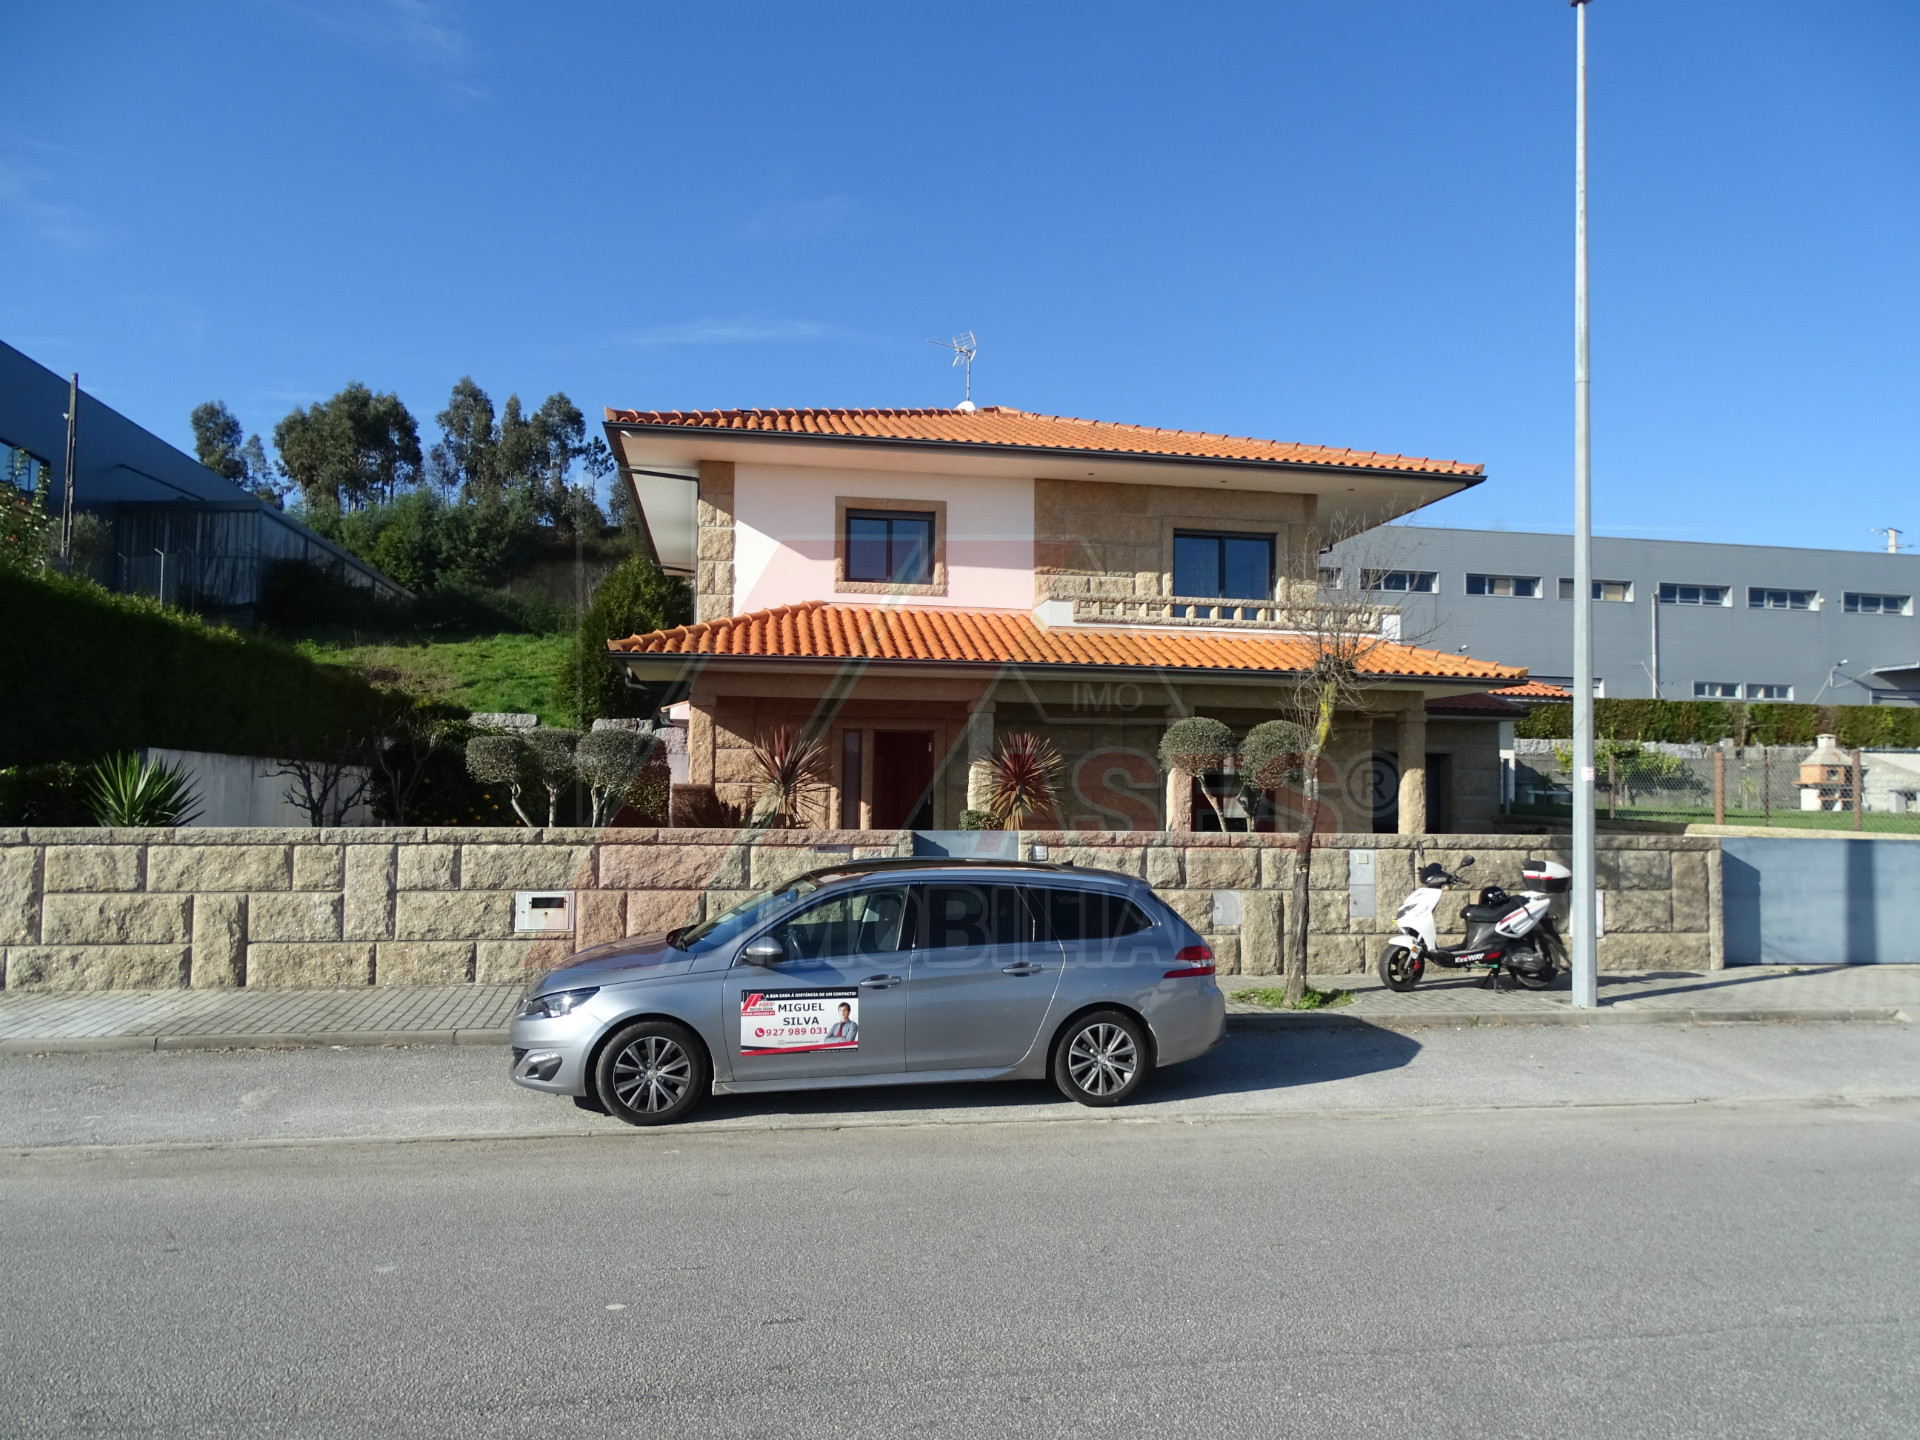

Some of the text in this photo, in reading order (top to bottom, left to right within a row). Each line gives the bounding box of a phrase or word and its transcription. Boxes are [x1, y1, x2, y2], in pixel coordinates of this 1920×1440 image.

[778, 1002, 825, 1012] MIGUEL
[783, 1016, 820, 1026] SILVA
[766, 1027, 828, 1036] 927 989 031
